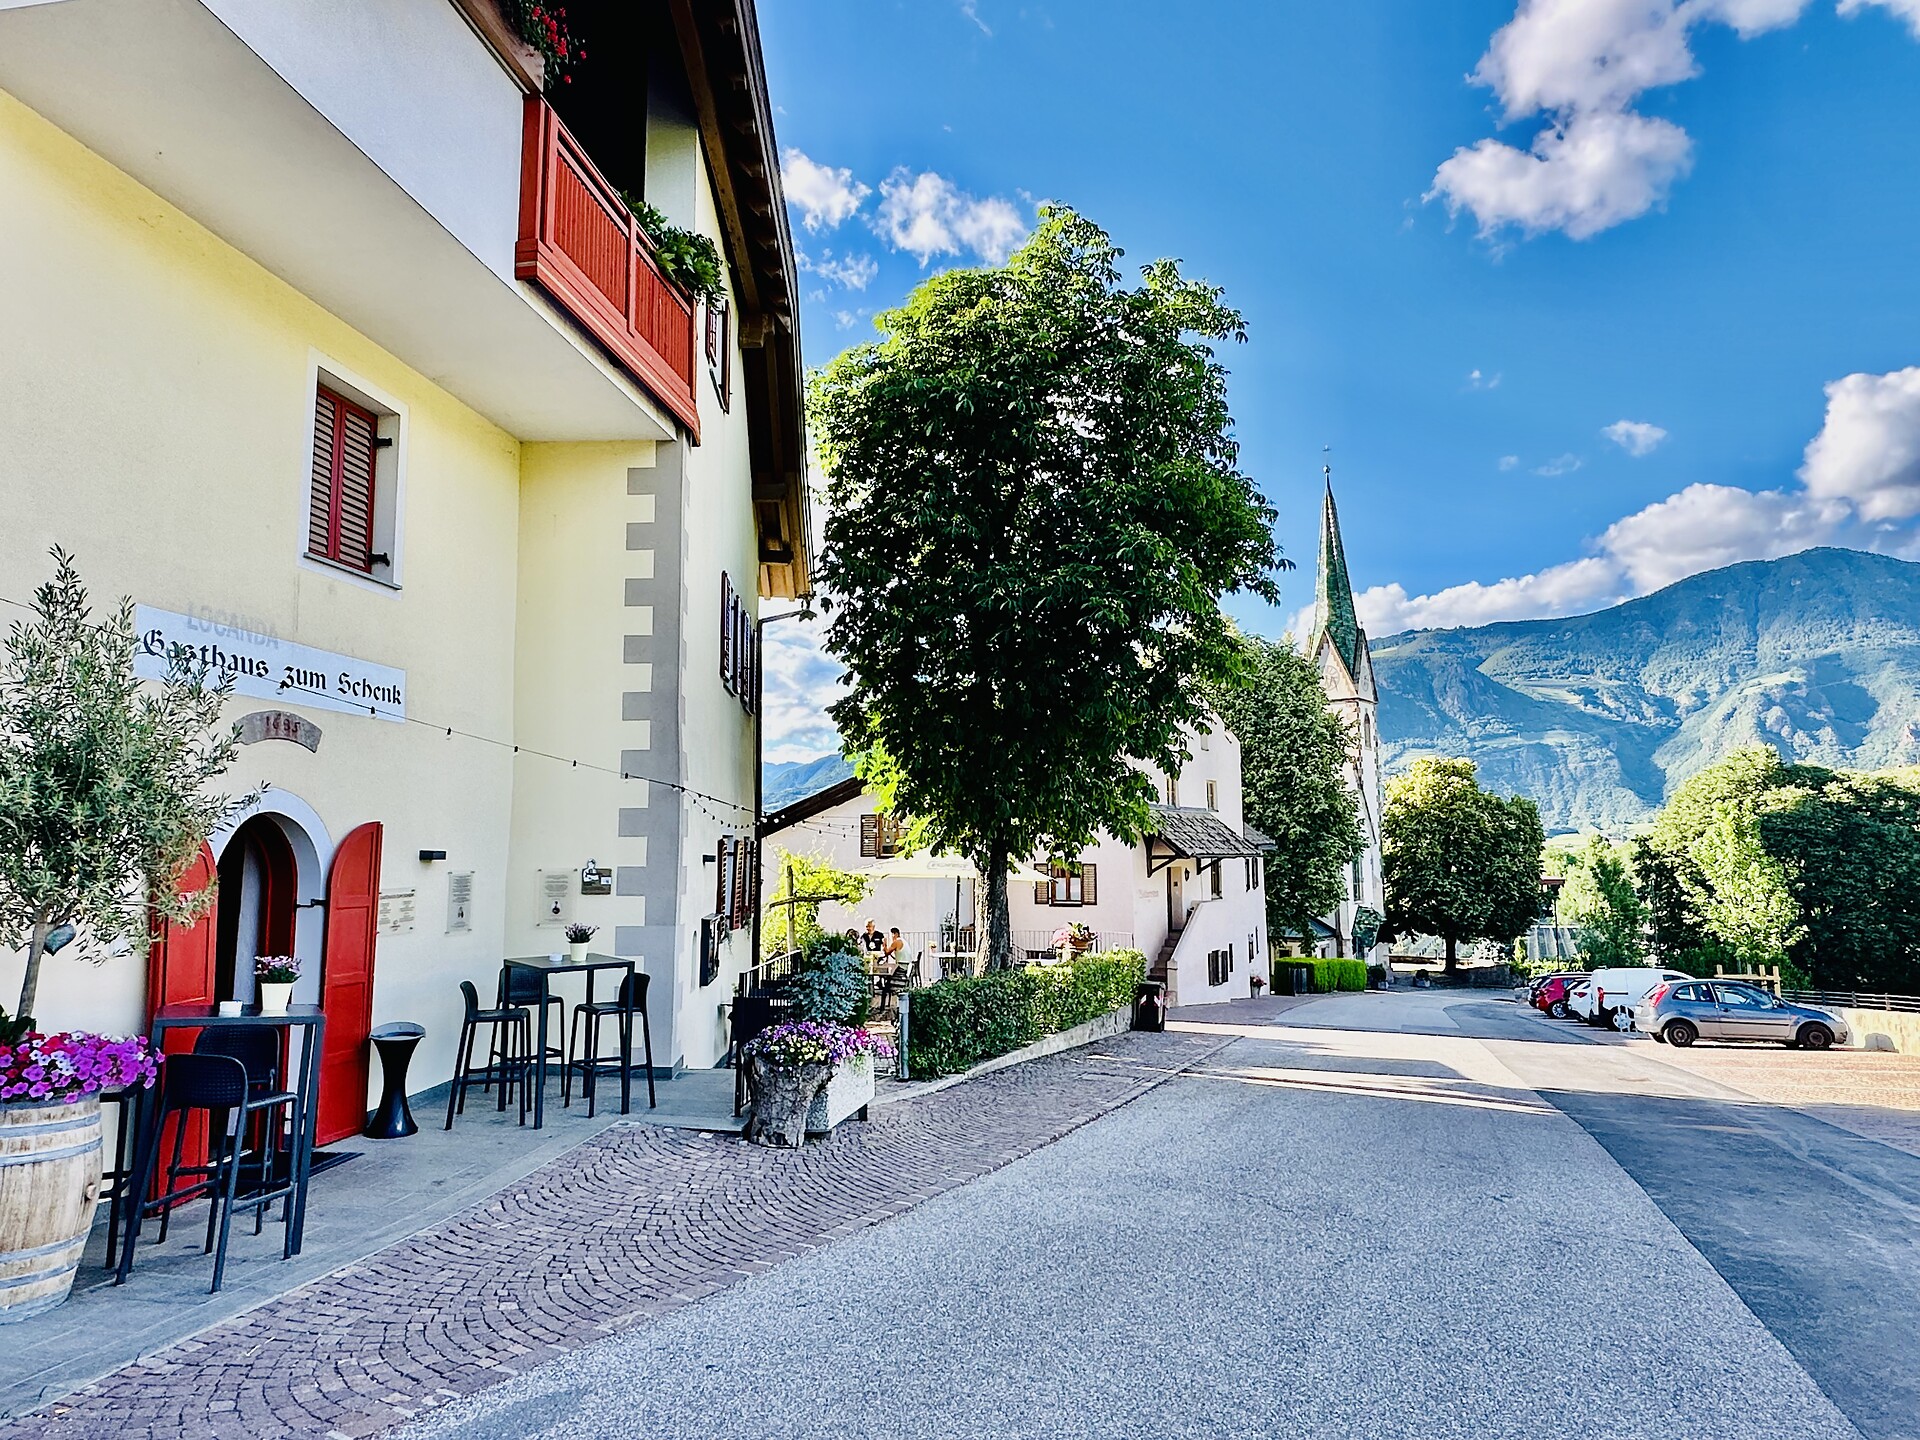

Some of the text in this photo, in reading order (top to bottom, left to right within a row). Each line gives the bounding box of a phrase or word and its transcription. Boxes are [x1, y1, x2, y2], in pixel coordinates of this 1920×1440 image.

[186, 602, 279, 649] LOCANDA
[282, 665, 326, 690] zum
[337, 672, 402, 705] Schenk
